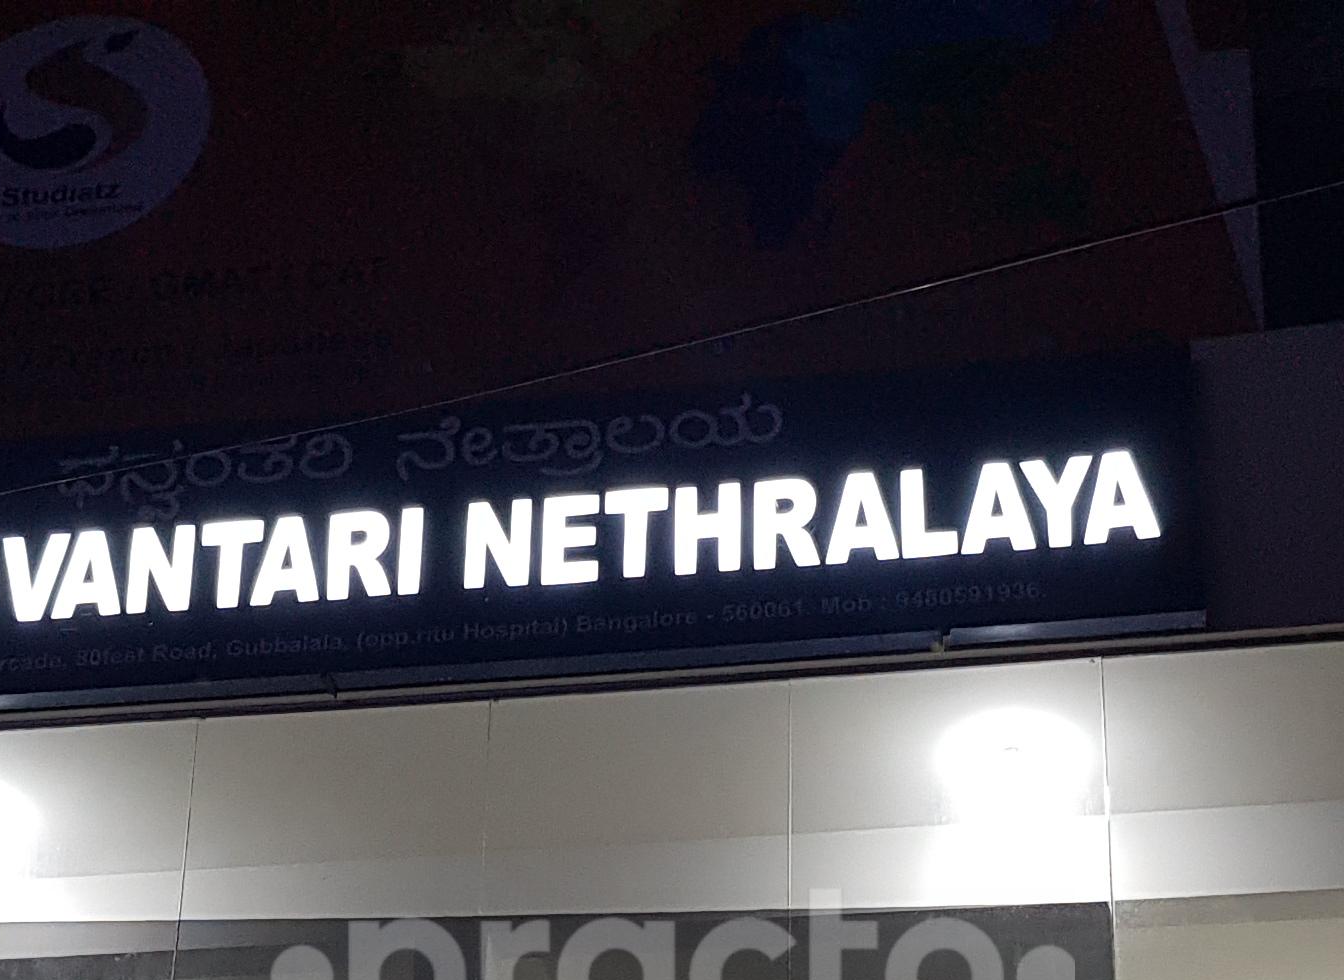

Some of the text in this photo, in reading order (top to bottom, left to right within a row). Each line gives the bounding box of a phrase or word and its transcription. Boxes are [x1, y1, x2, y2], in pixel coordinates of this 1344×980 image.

[462, 449, 1163, 590] NETHRALAYA
[463, 616, 568, 643] Hospital)
[576, 608, 698, 635] Bangalore
